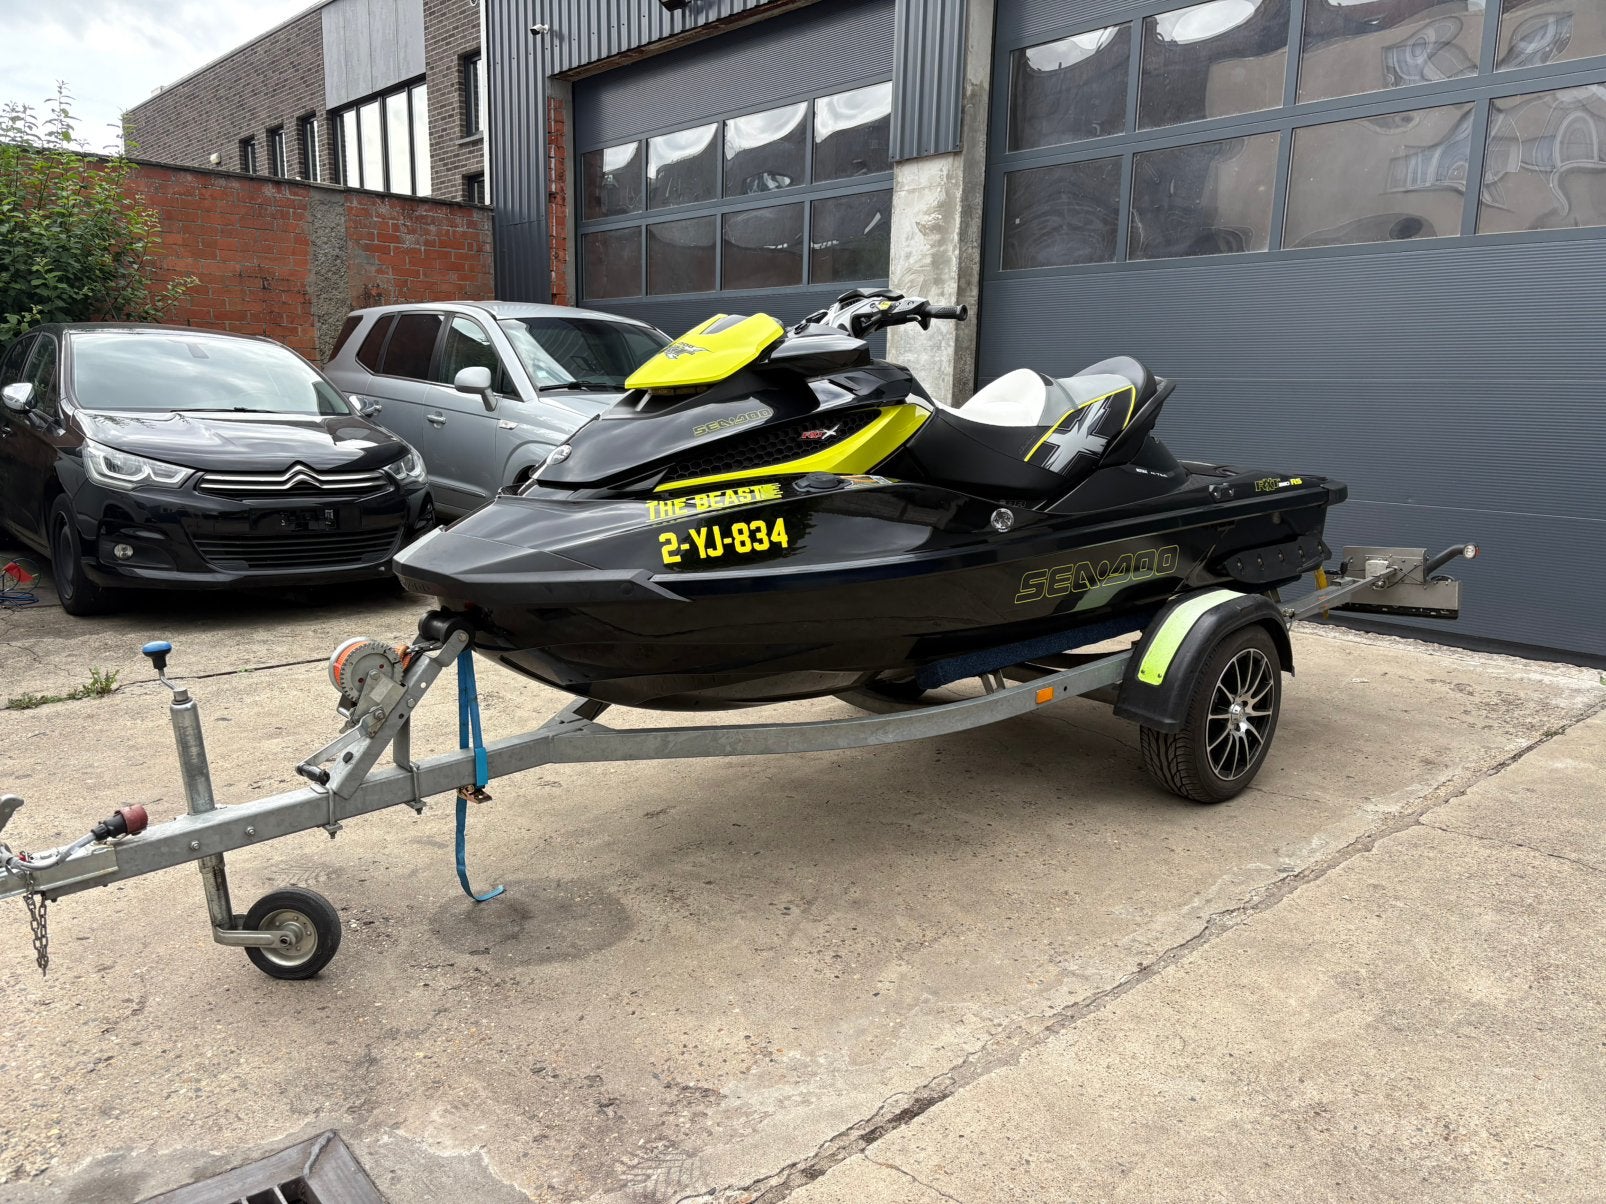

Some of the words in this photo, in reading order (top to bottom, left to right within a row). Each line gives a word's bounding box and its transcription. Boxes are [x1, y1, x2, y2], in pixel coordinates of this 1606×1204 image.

[645, 497, 688, 521] THE
[694, 485, 765, 511] BEAST
[658, 517, 788, 564] 2-YJ-834
